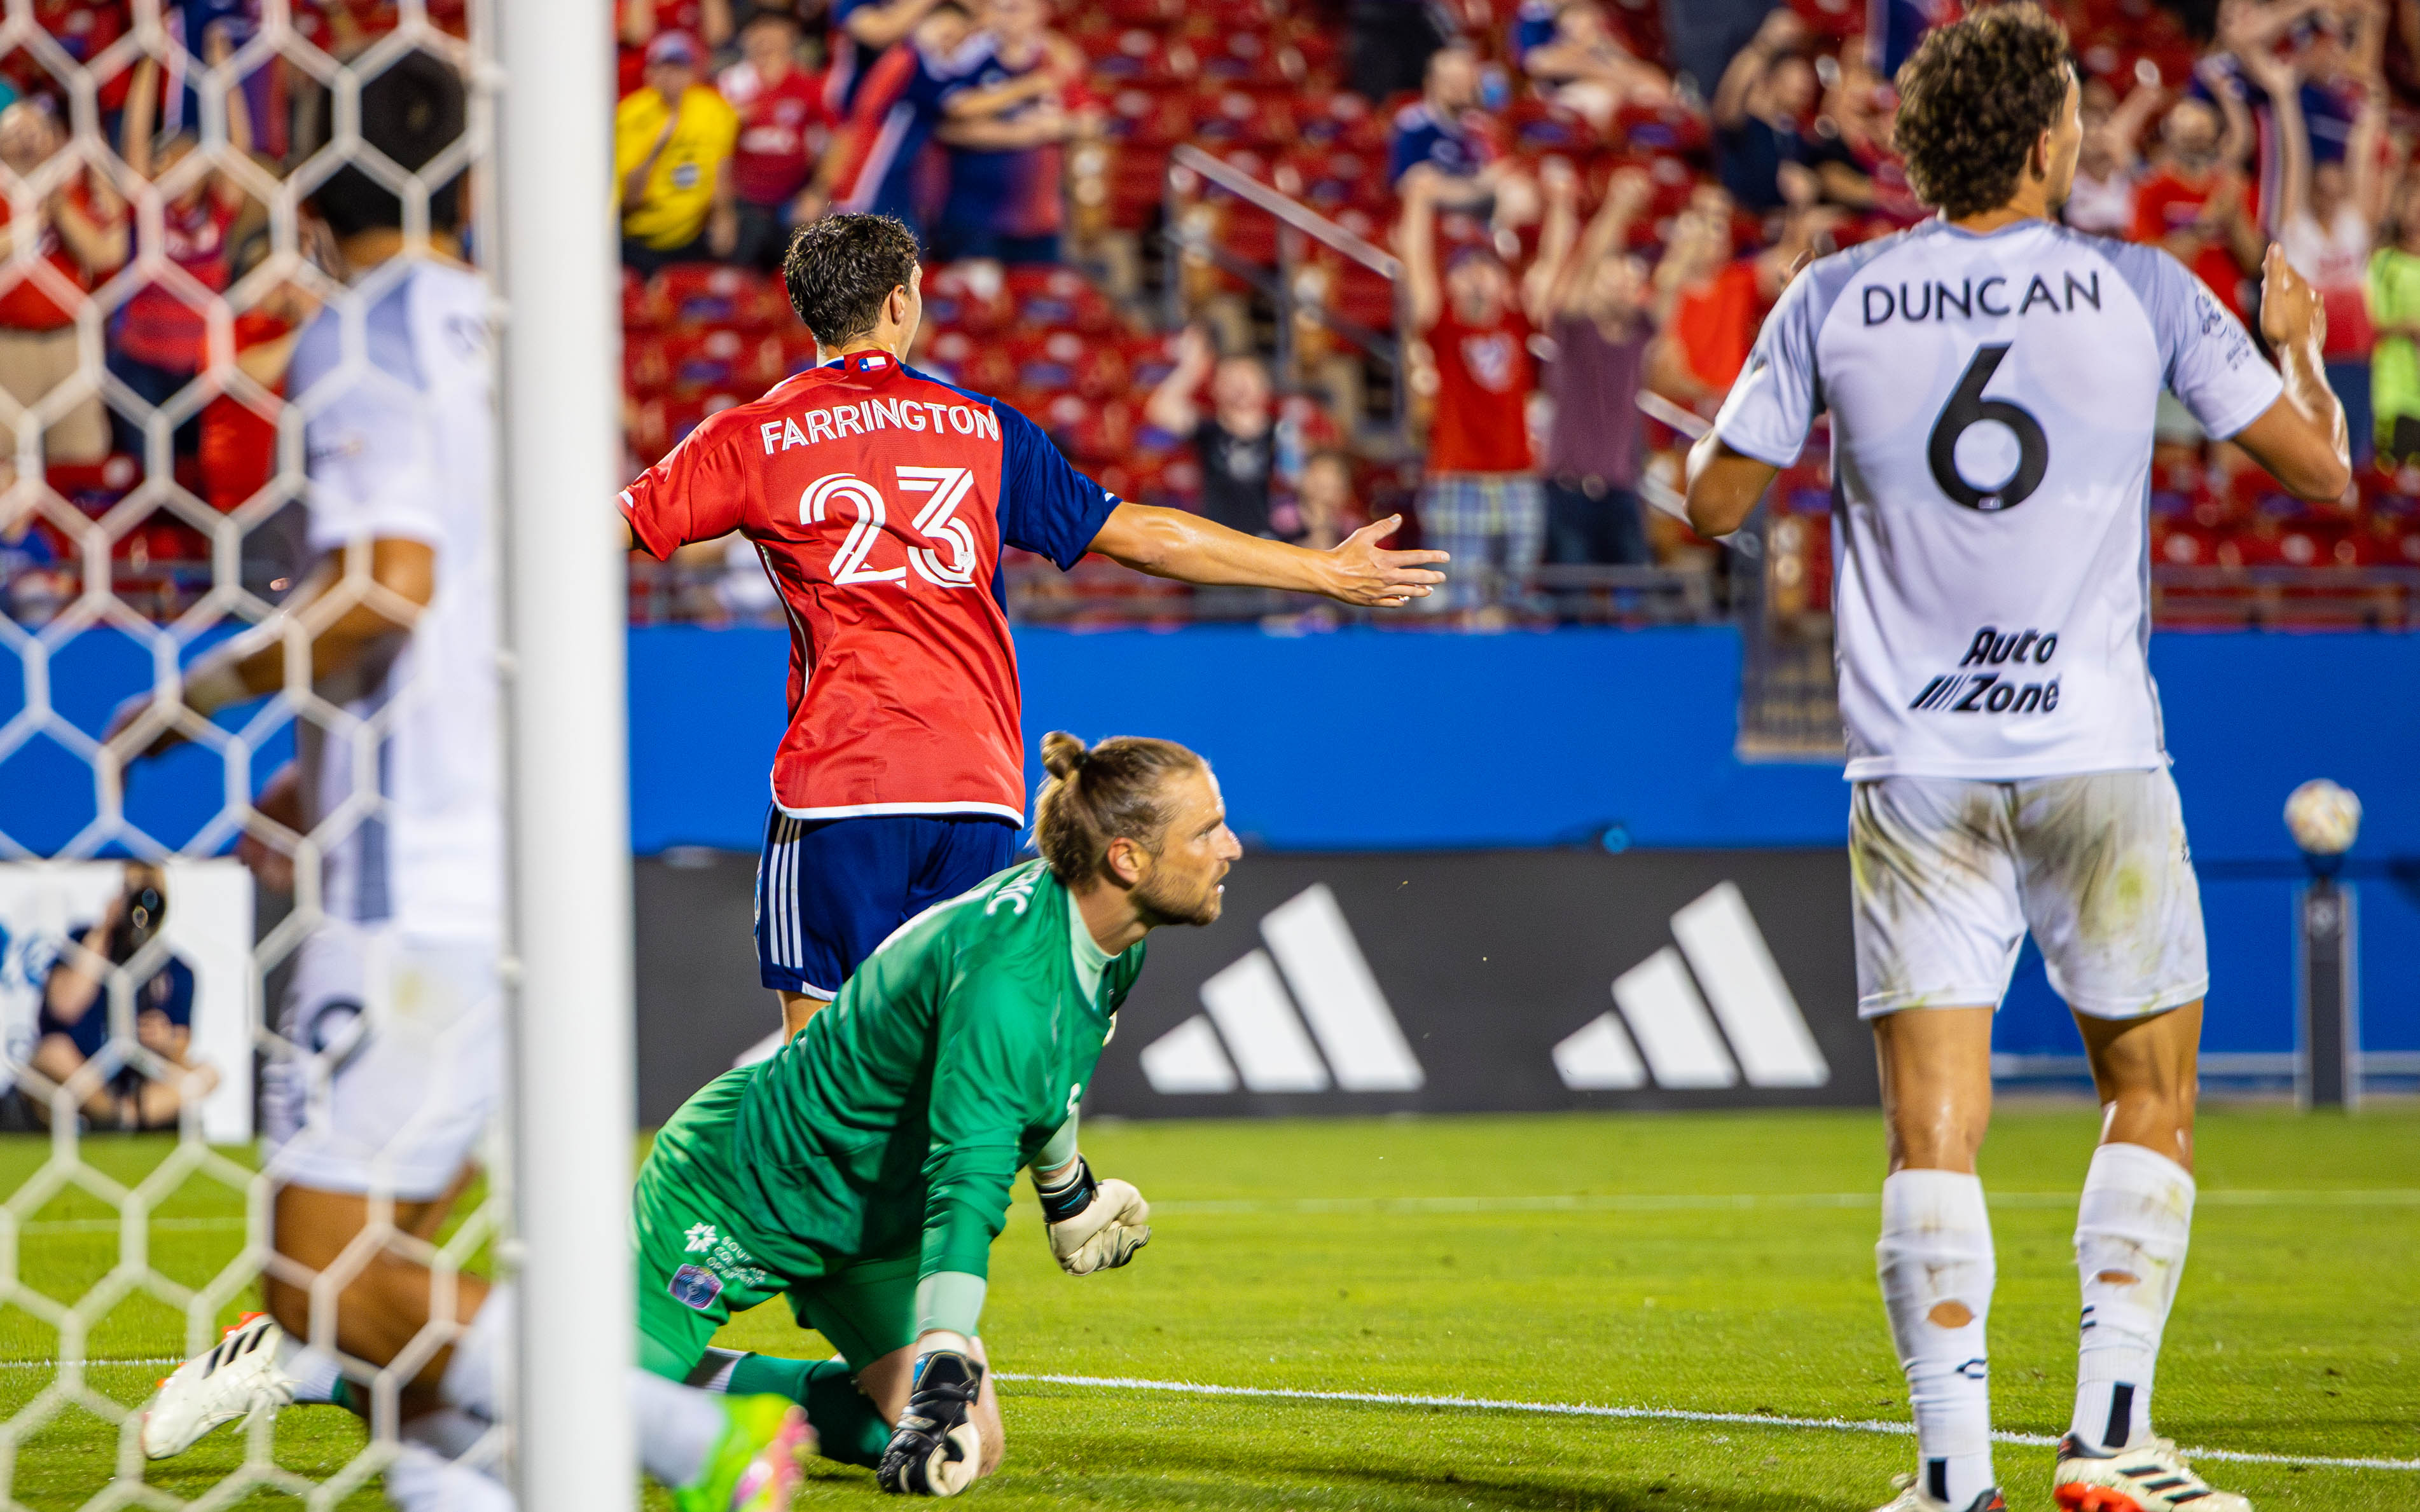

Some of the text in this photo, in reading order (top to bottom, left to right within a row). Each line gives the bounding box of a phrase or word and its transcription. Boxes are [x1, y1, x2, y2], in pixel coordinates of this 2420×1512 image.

[1863, 270, 2101, 326] DUNCAN
[760, 398, 1000, 455] FARRINGTON
[1926, 339, 2049, 512] 6
[799, 466, 976, 589] 23
[1958, 625, 2059, 668] Auto
[1950, 671, 2061, 714] Zone
